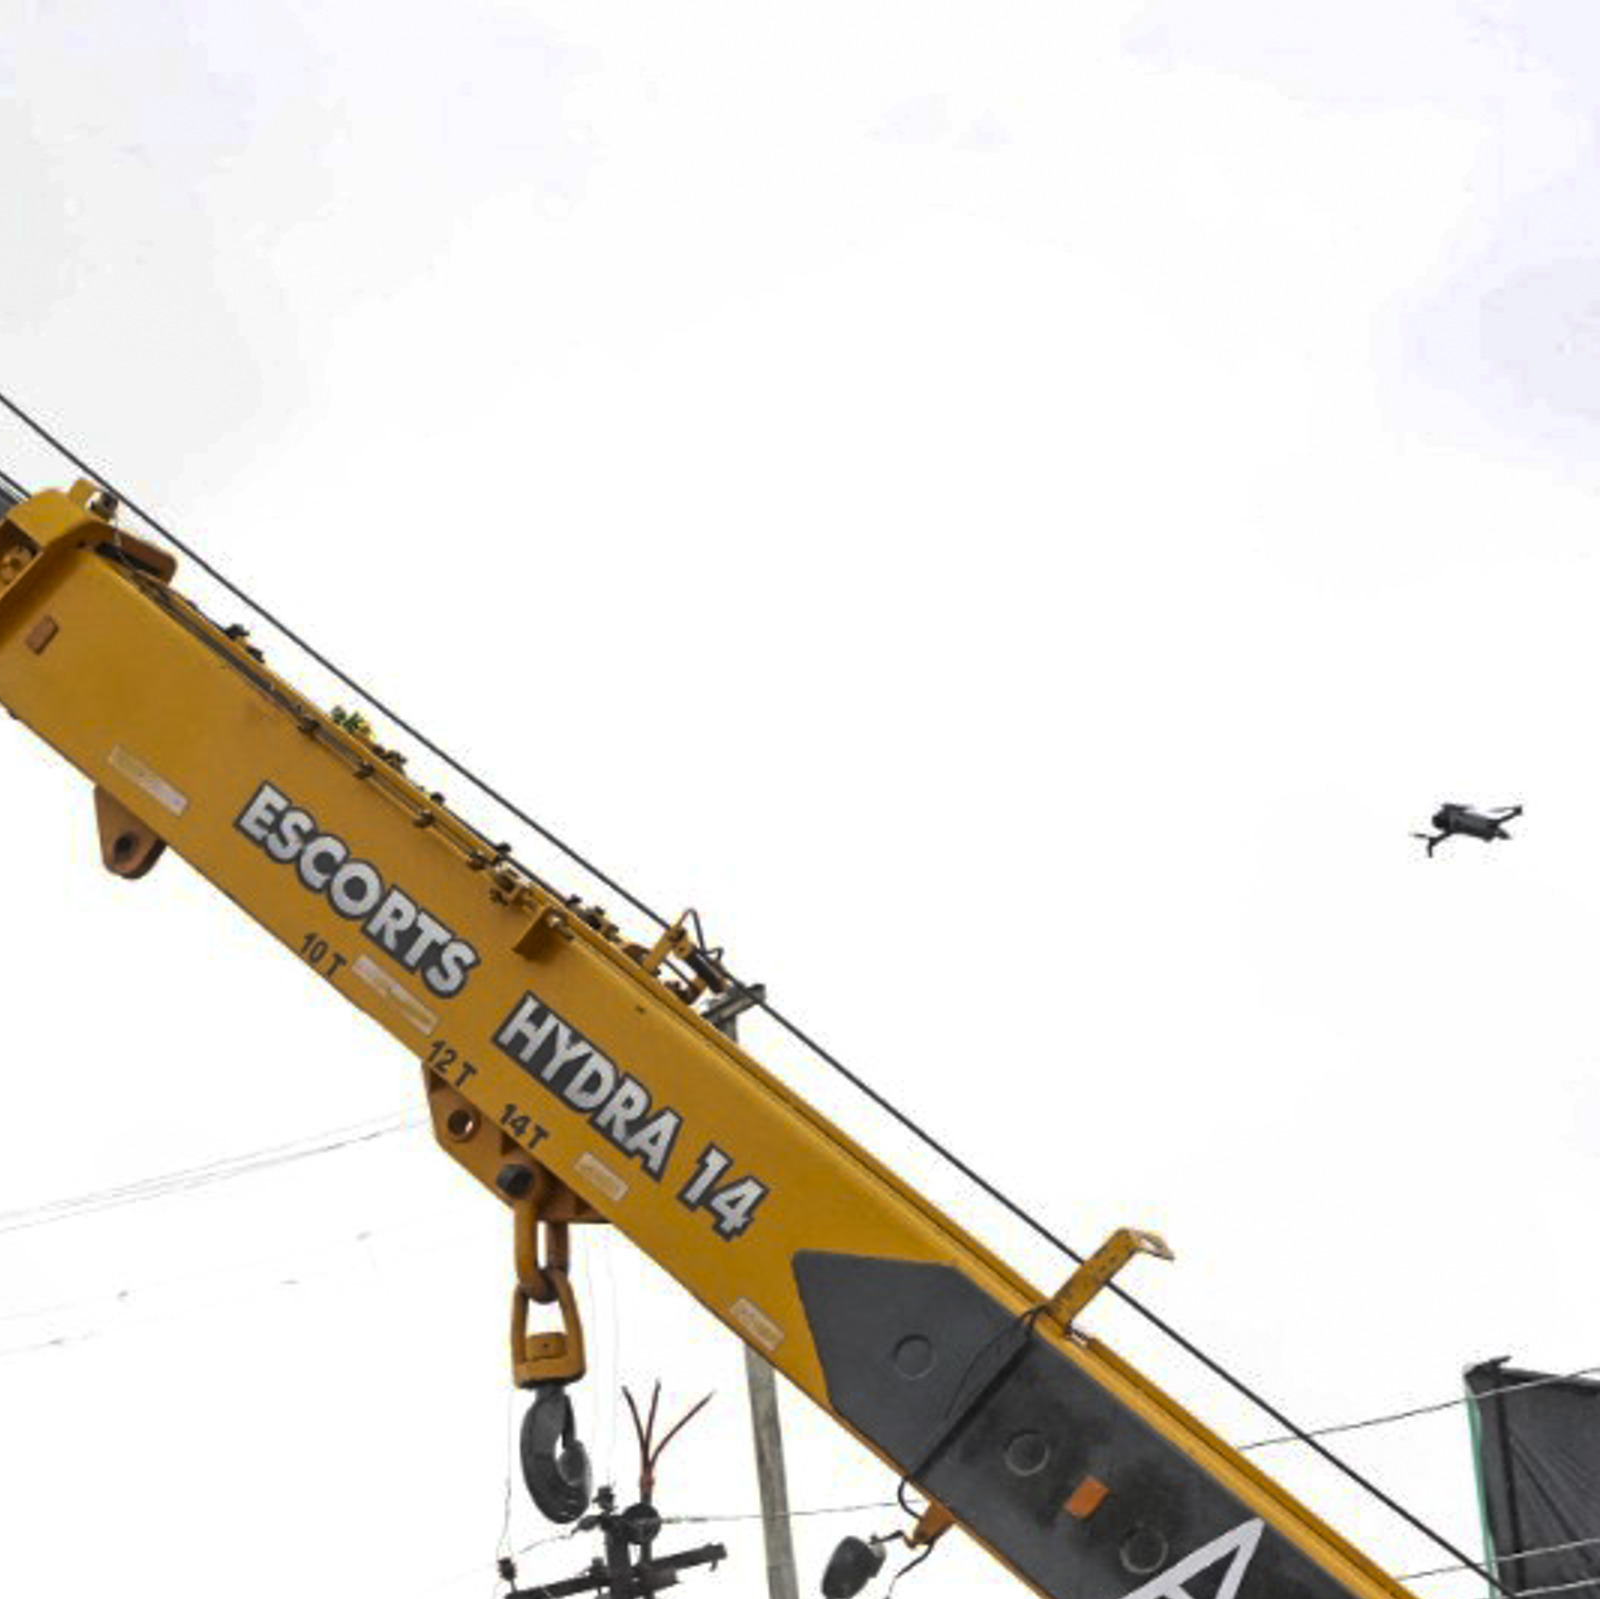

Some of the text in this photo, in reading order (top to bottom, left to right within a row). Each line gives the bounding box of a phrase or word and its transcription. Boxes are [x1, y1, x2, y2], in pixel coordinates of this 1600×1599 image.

[234, 780, 770, 1241] ESCORTS HYDRA 14
